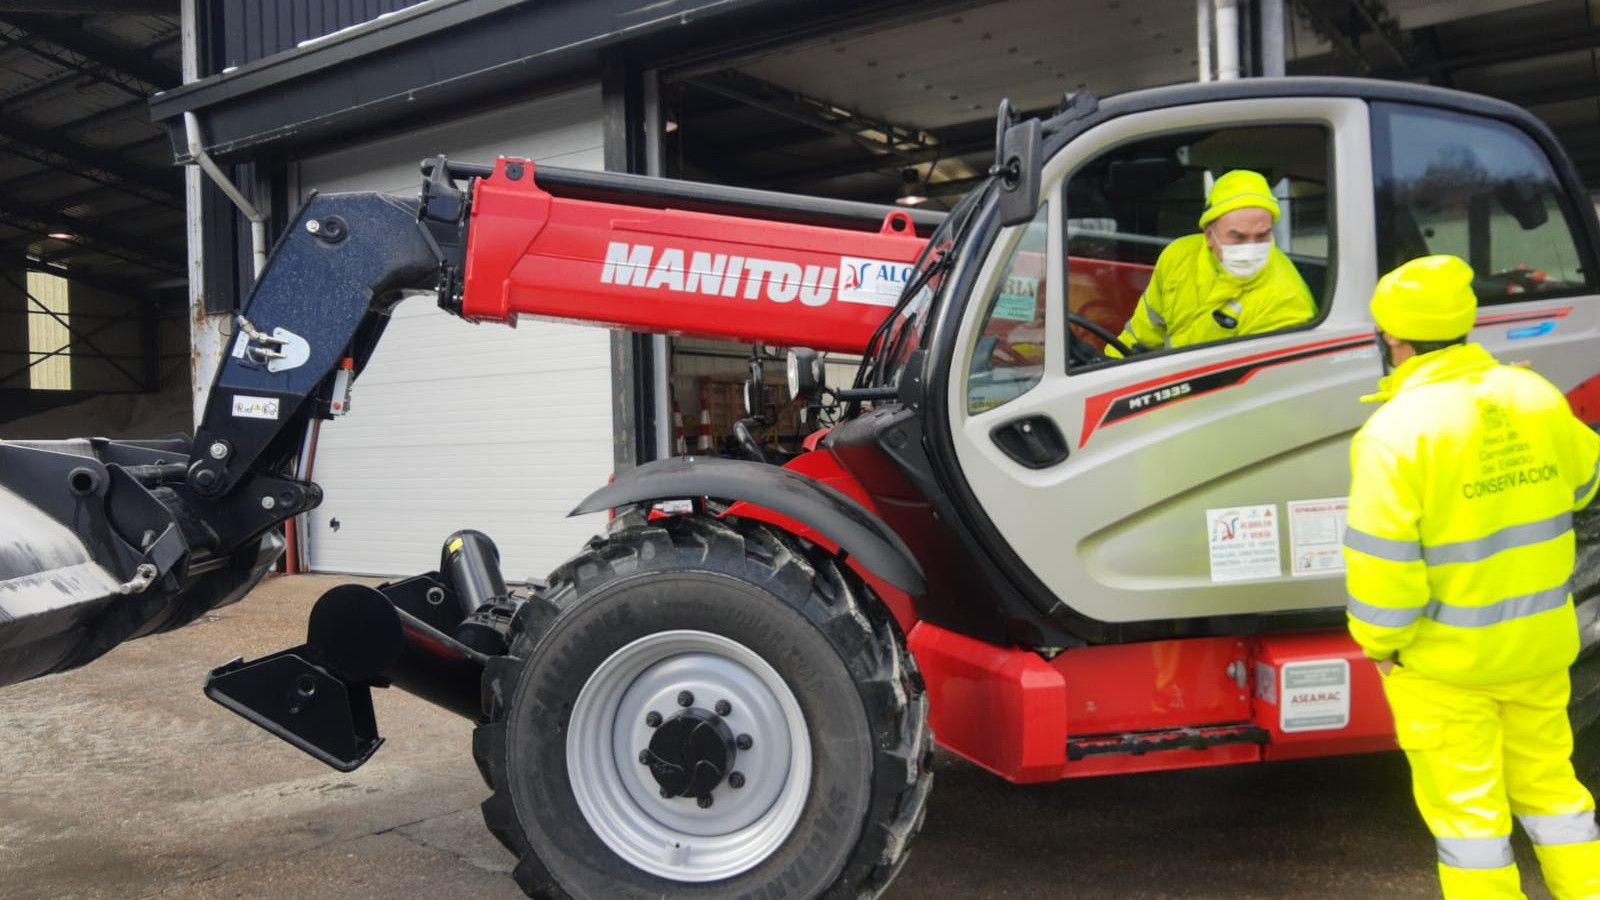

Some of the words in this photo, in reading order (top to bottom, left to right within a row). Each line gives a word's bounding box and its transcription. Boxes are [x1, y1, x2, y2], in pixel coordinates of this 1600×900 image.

[600, 242, 838, 306] MANITOU
[1129, 394, 1152, 409] MT
[1153, 383, 1191, 401] 1335
[1463, 461, 1559, 499] CONSERVACIÓN
[1291, 691, 1341, 704] ASEAMAC
